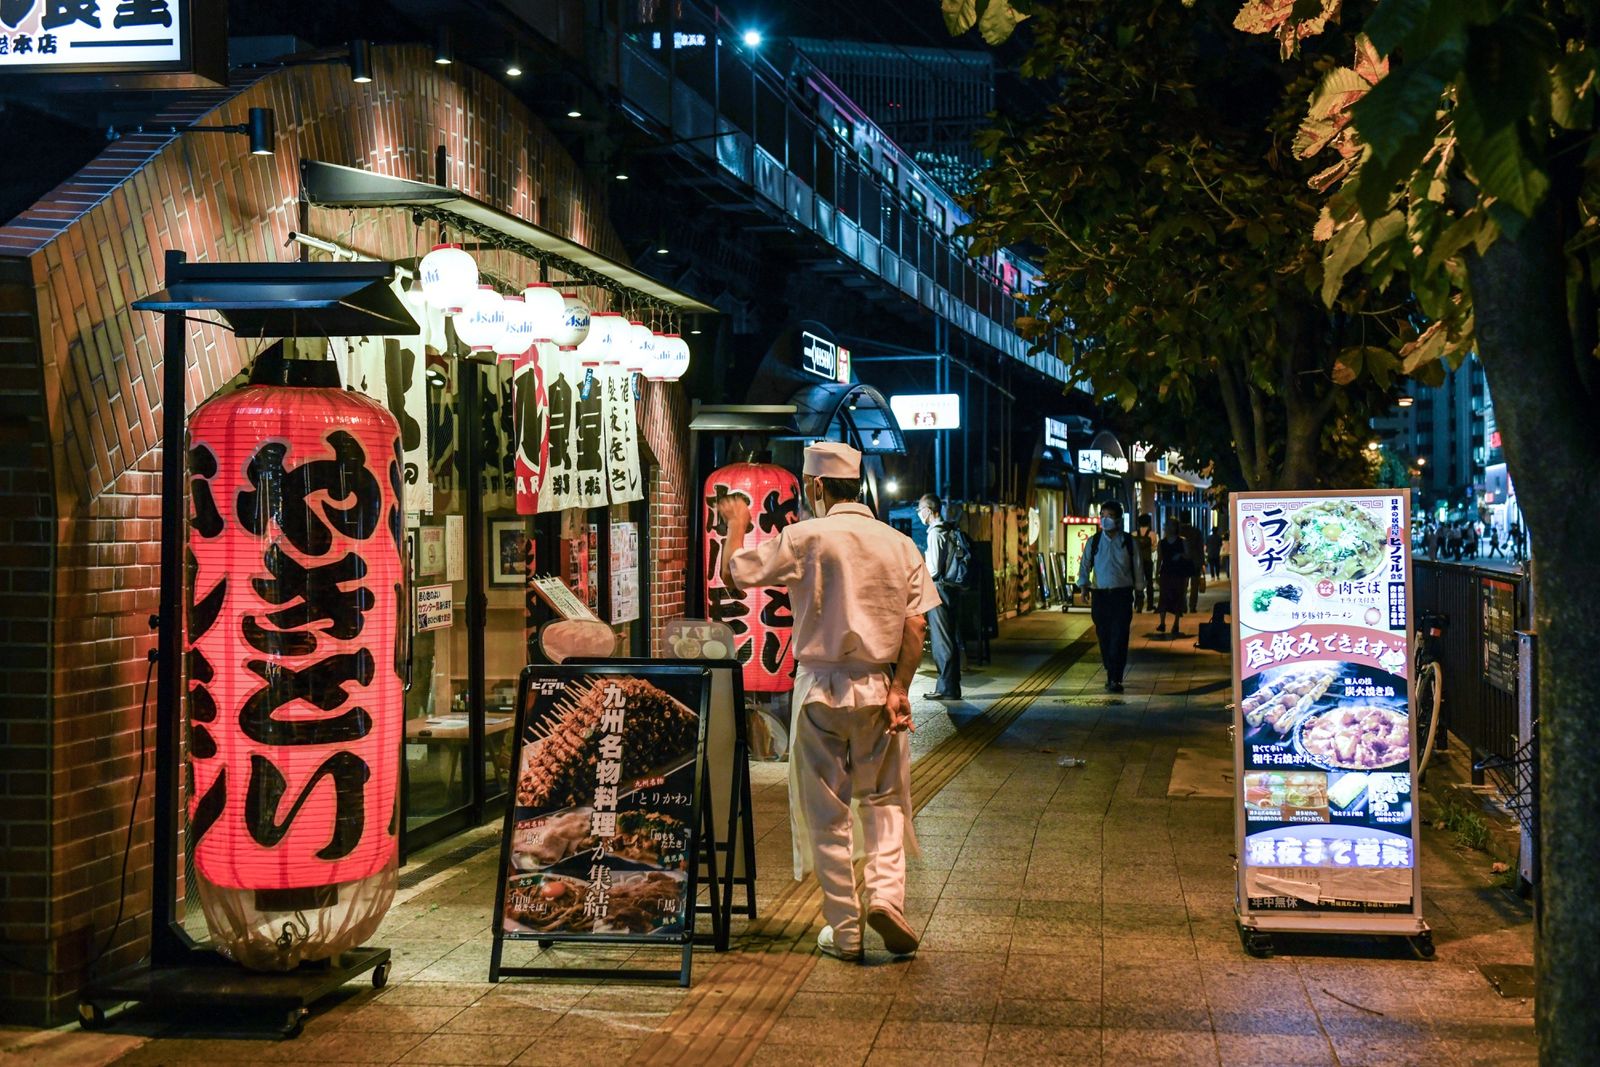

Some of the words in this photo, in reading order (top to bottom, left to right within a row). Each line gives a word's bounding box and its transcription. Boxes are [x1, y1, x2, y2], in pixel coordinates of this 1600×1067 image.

[565, 315, 591, 327] Asah
[1247, 521, 1259, 551] ラーメン
[1258, 508, 1291, 572] ランチ
[1390, 537, 1402, 572] ヒノマル
[1338, 581, 1381, 595] 肉そば
[236, 431, 382, 860] やきとり
[1246, 631, 1388, 669] 昼飲みできます
[531, 682, 566, 690] ヒノマル
[1344, 685, 1395, 697] 炭火焼き鳥
[1252, 753, 1331, 765] 和牛石焼ホルモン
[583, 684, 626, 918] 九州名物料理が集結
[1248, 837, 1409, 866] 深夜まで営業
